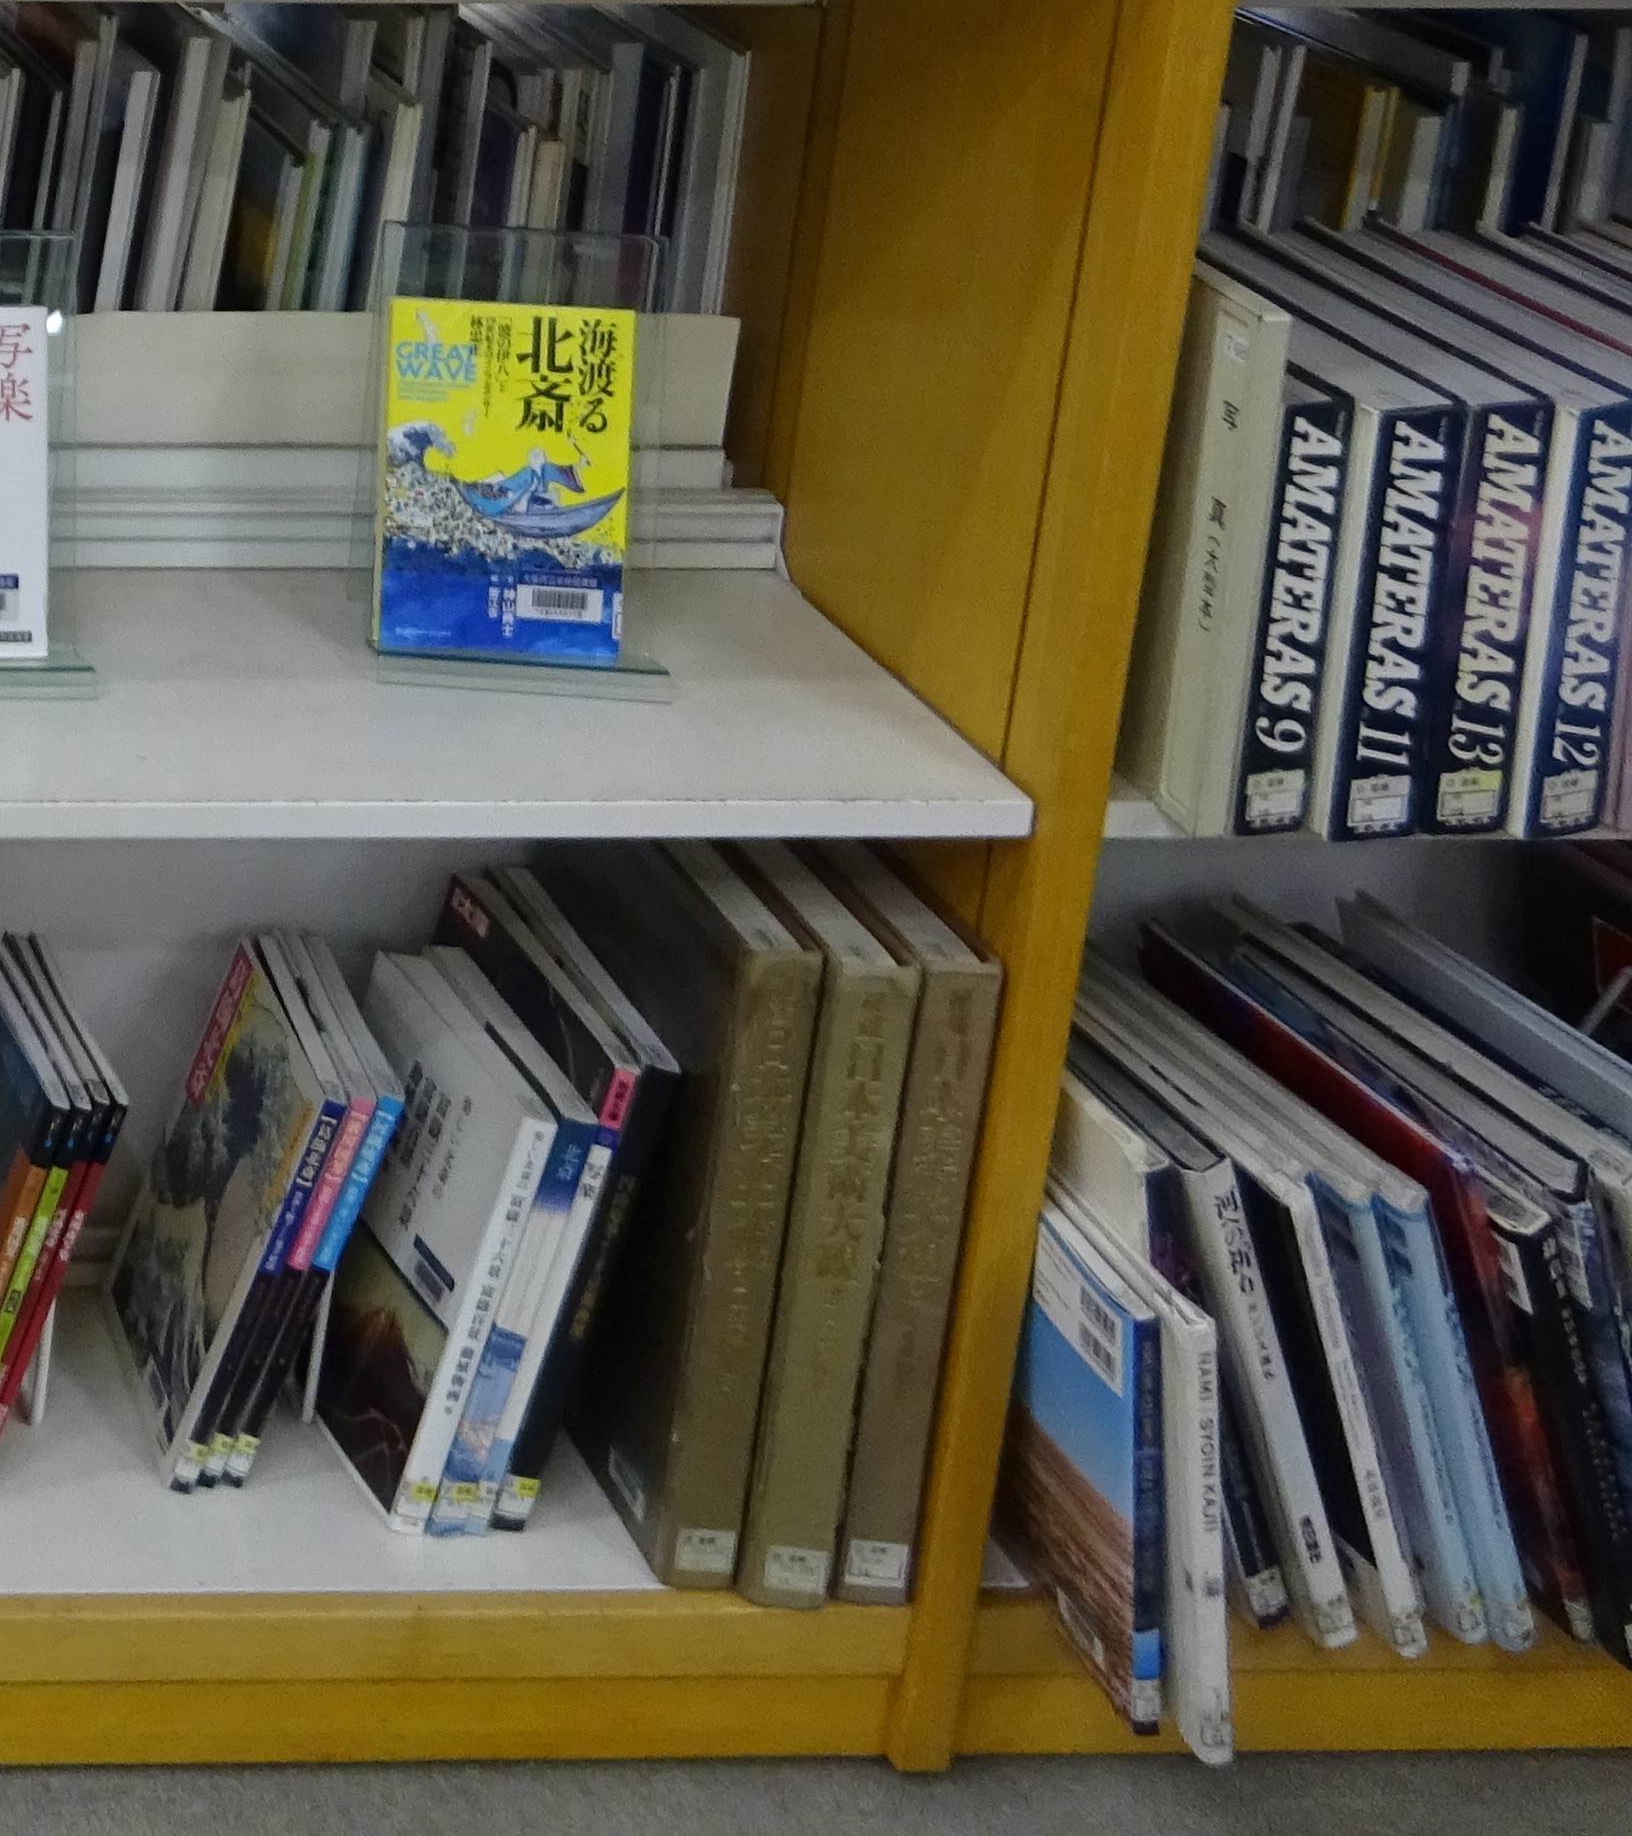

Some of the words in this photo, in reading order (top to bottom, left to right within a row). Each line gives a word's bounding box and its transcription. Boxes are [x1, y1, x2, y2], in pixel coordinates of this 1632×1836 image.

[395, 340, 478, 361] GREAT
[397, 360, 477, 382] WAVE
[515, 315, 575, 433] 北斎
[577, 317, 619, 434] 海渡る
[1260, 417, 1342, 712] AMATERAS
[1363, 421, 1445, 718] AMATERAS
[1455, 413, 1539, 711] AMATERAS
[1255, 718, 1307, 752] 9
[1355, 723, 1412, 765] 11
[1447, 717, 1507, 764] 13
[1552, 716, 1602, 765] 12
